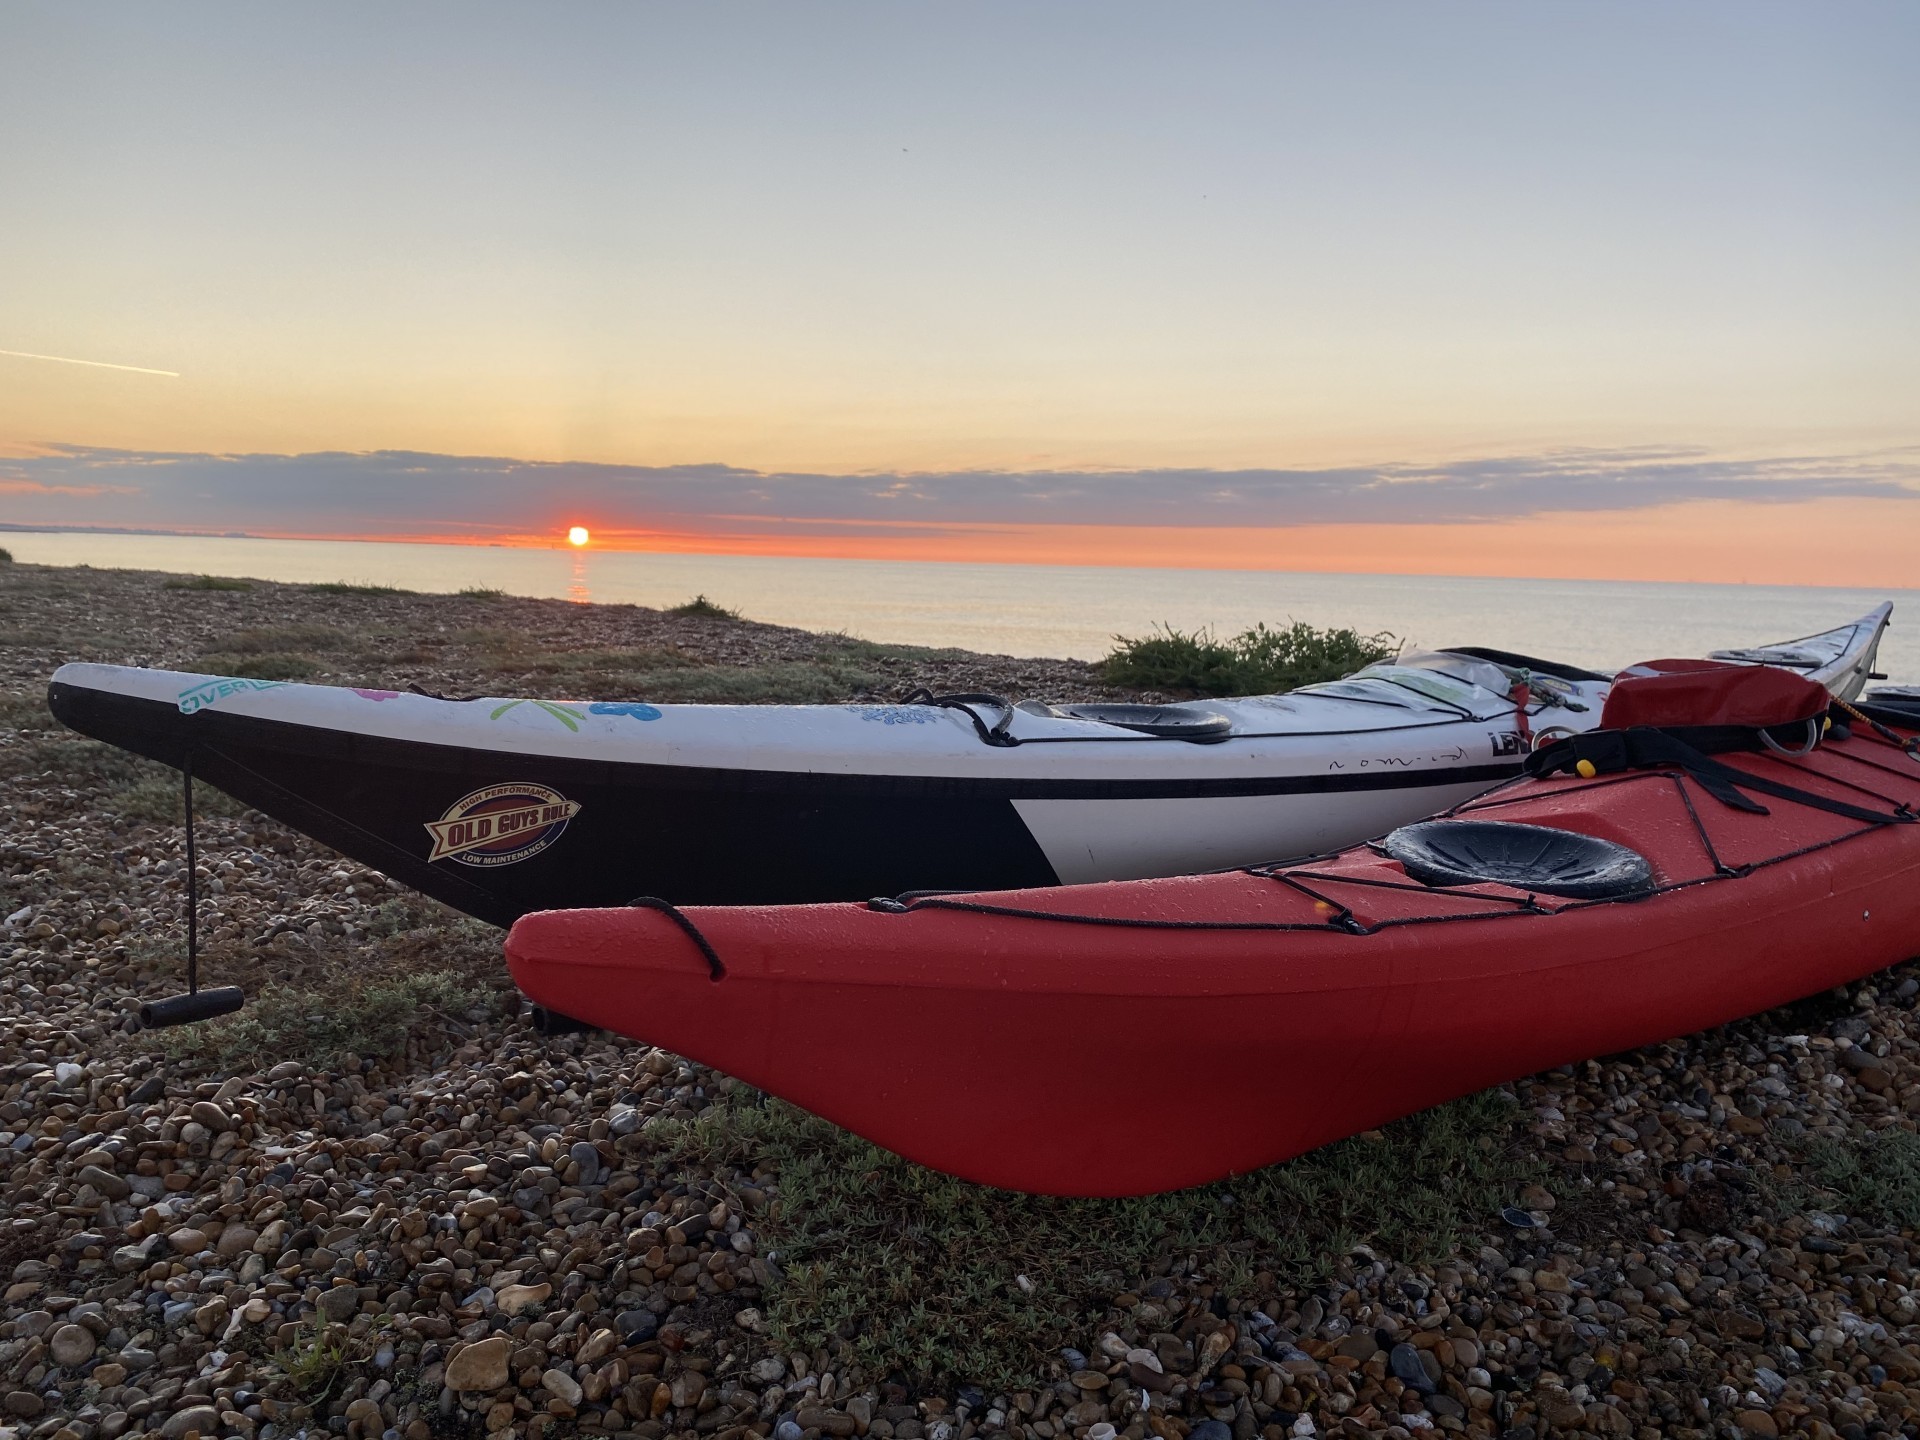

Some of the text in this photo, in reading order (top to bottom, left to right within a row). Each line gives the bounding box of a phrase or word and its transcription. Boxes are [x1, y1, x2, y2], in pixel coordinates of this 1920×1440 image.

[459, 785, 553, 811] HIGH PERFORMANCE
[447, 803, 571, 847] OLD GUYS RULE
[462, 839, 547, 864] LOW MAINTENANCE
